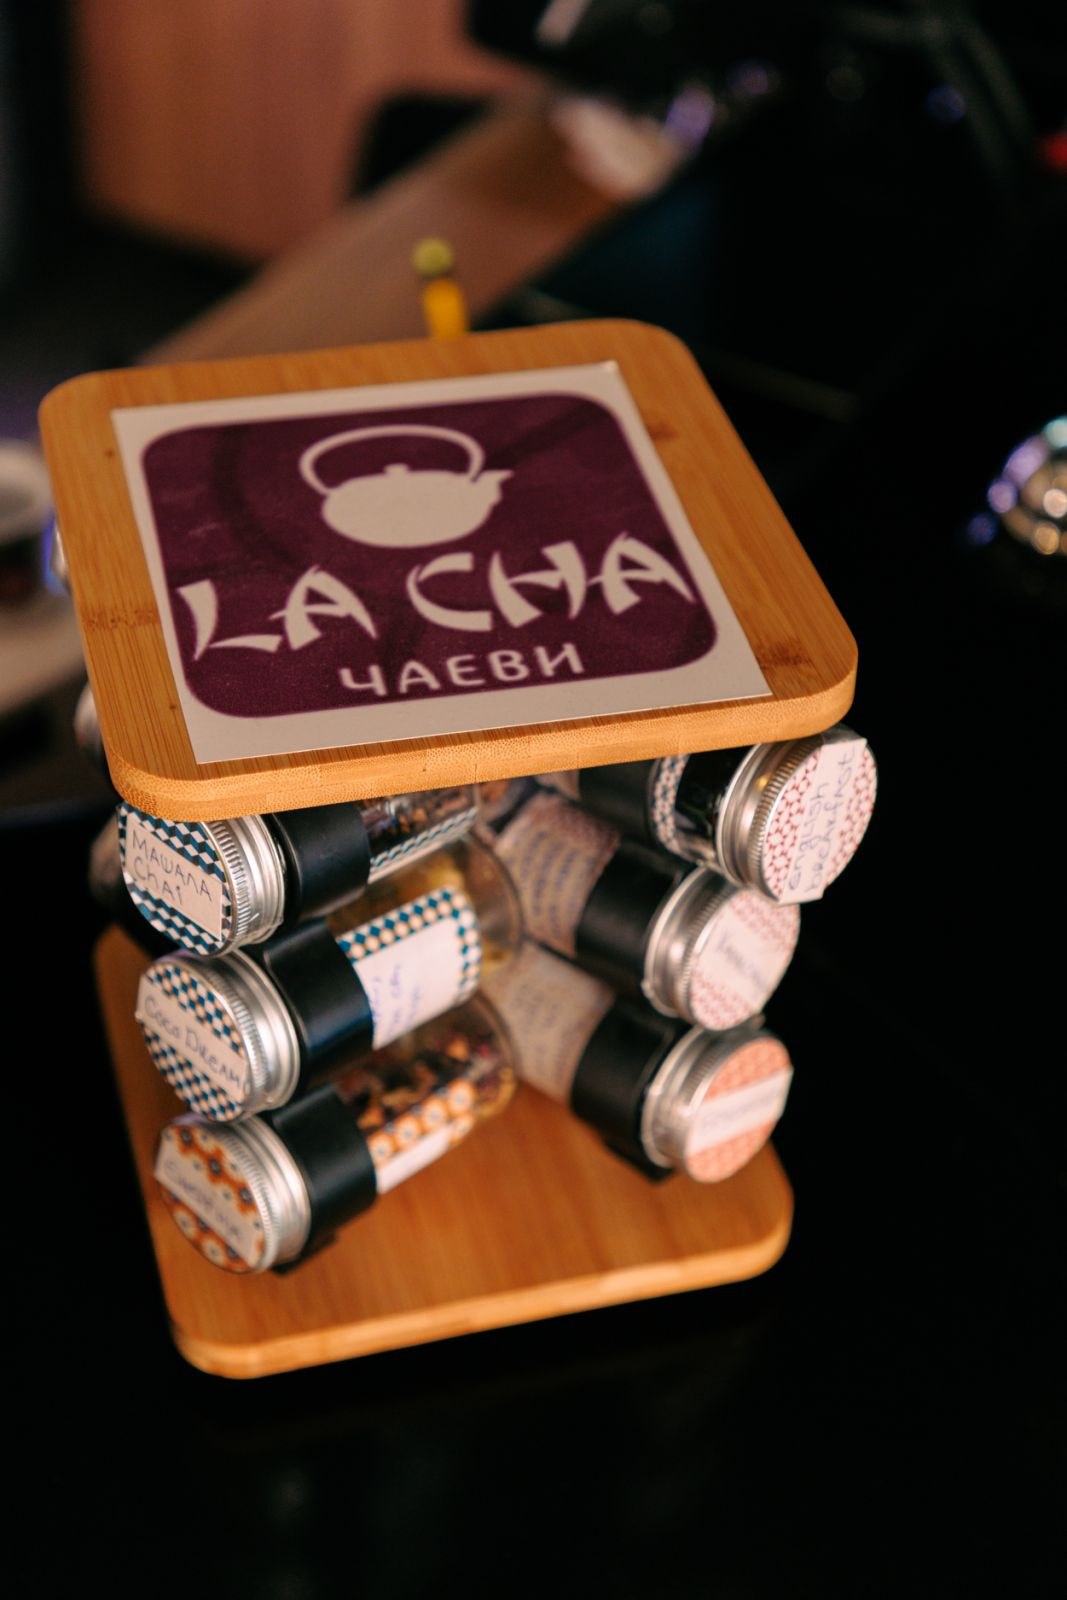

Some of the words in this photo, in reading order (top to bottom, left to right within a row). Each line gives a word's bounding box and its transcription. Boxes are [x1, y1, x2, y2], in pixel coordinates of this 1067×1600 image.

[176, 564, 378, 662] LA
[406, 531, 696, 632] CHA
[339, 642, 585, 697] ЧАЕВИ
